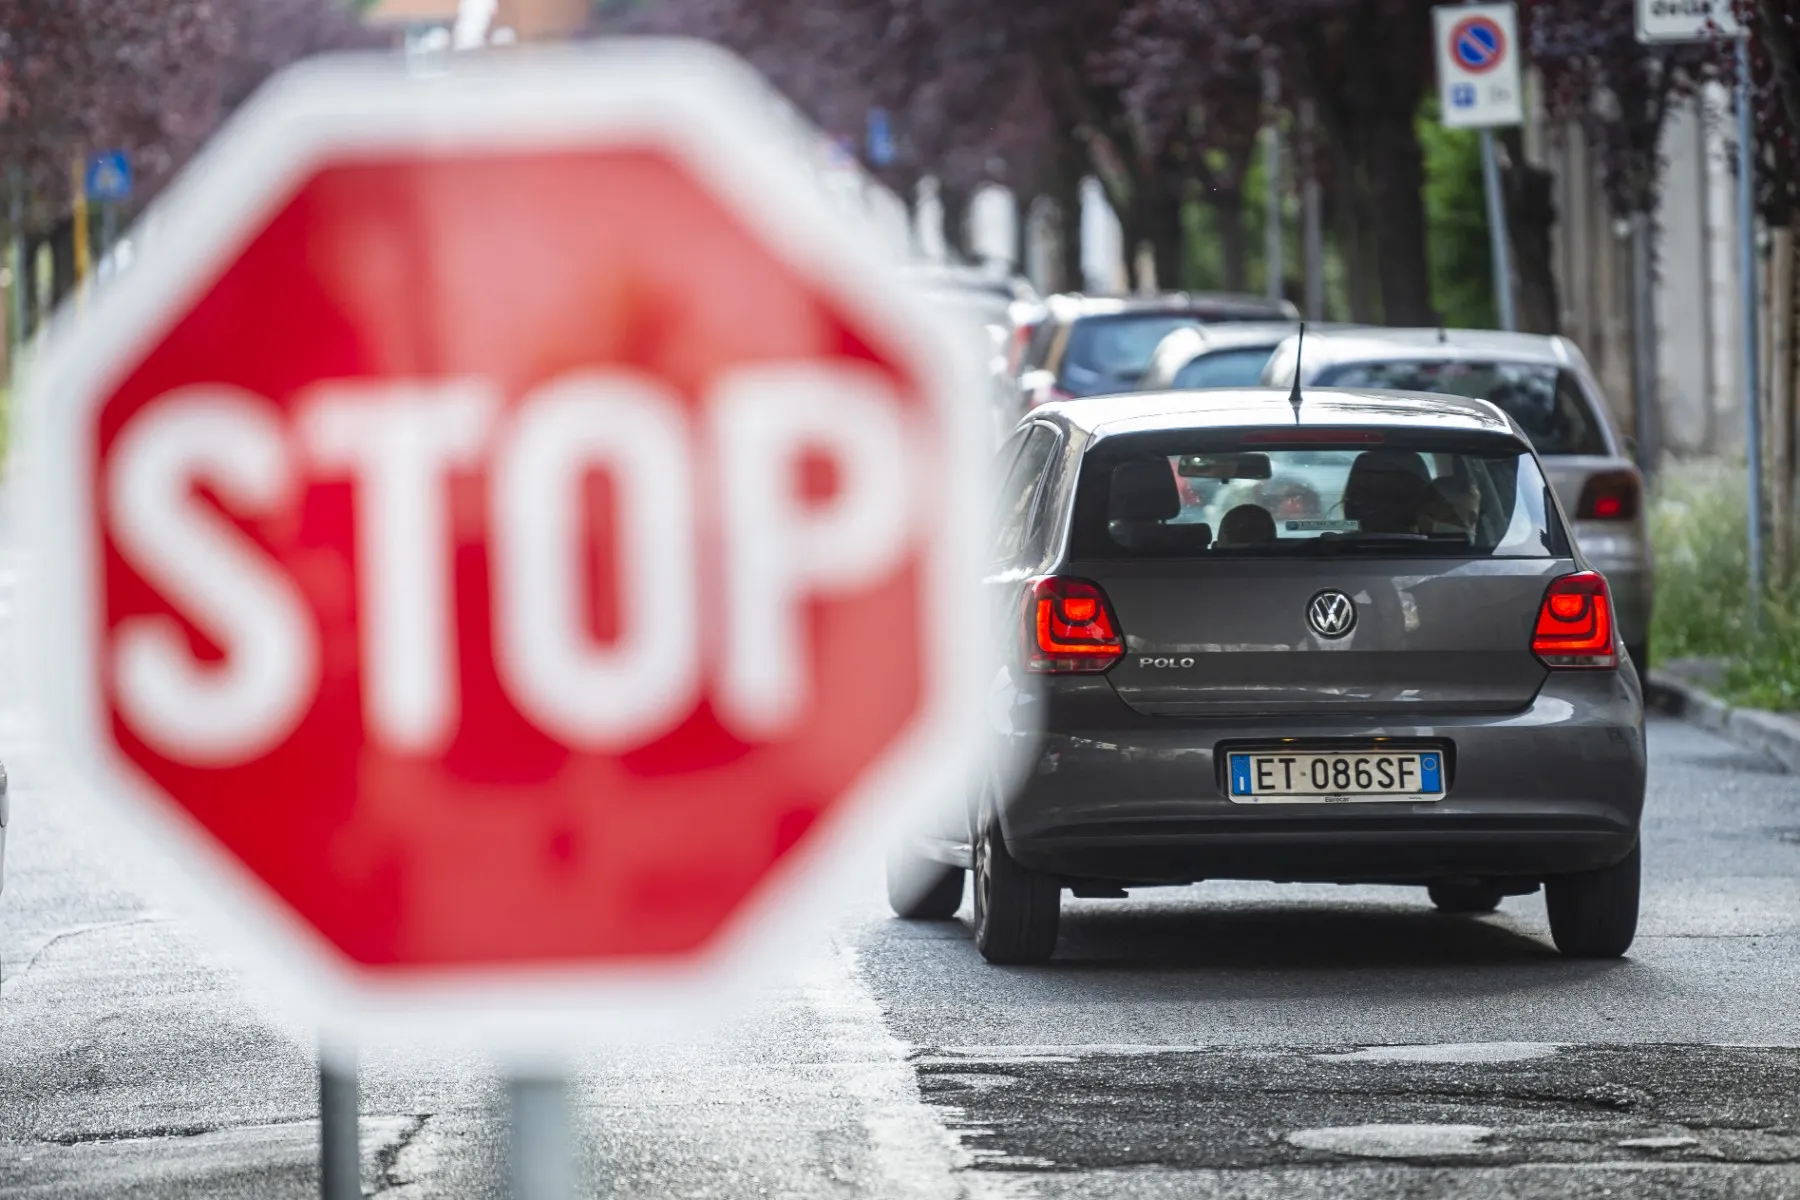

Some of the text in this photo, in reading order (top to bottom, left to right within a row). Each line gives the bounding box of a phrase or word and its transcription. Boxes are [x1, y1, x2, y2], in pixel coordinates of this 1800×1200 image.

[107, 359, 910, 766] STOP
[1139, 657, 1195, 669] POLO
[1256, 758, 1296, 790] ET
[1311, 757, 1416, 789] 086SF
